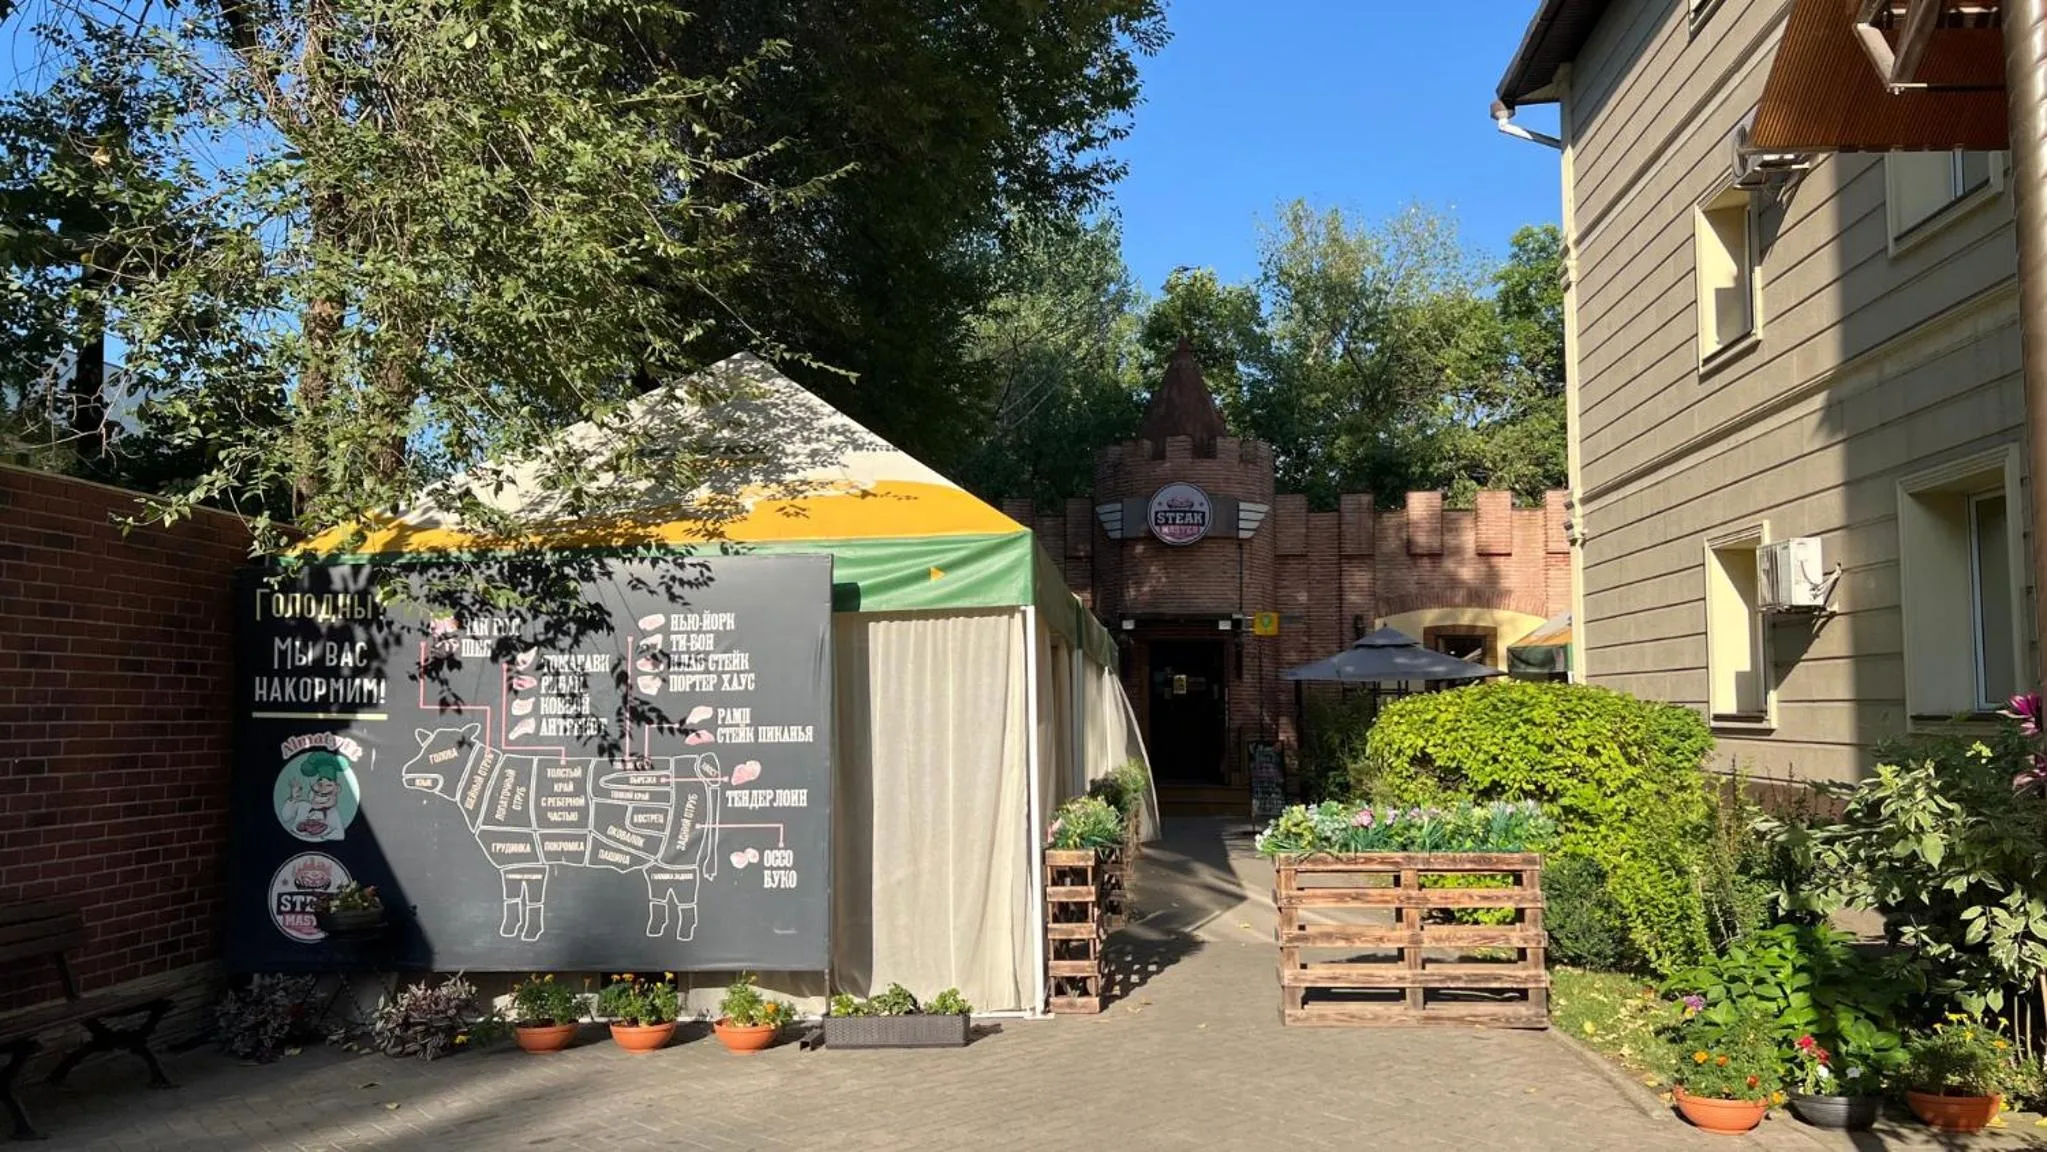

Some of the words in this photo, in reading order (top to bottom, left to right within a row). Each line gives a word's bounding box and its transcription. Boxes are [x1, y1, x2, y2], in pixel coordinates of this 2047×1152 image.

[1156, 511, 1204, 525] STEAK
[670, 609, 736, 632] НЬЮ-ЙОРК
[670, 633, 715, 652] ТИ-БОН
[707, 649, 750, 671] СТЕЙК
[668, 673, 719, 693] ПОРТЕР
[720, 672, 756, 692] ХАУС
[717, 707, 752, 725] РАМП
[717, 722, 755, 743] СТЕЙК
[758, 725, 814, 743] ПИКАНЬЯ
[763, 849, 794, 868] ОССО
[763, 869, 798, 889] БУКО
[279, 894, 318, 913] STE
